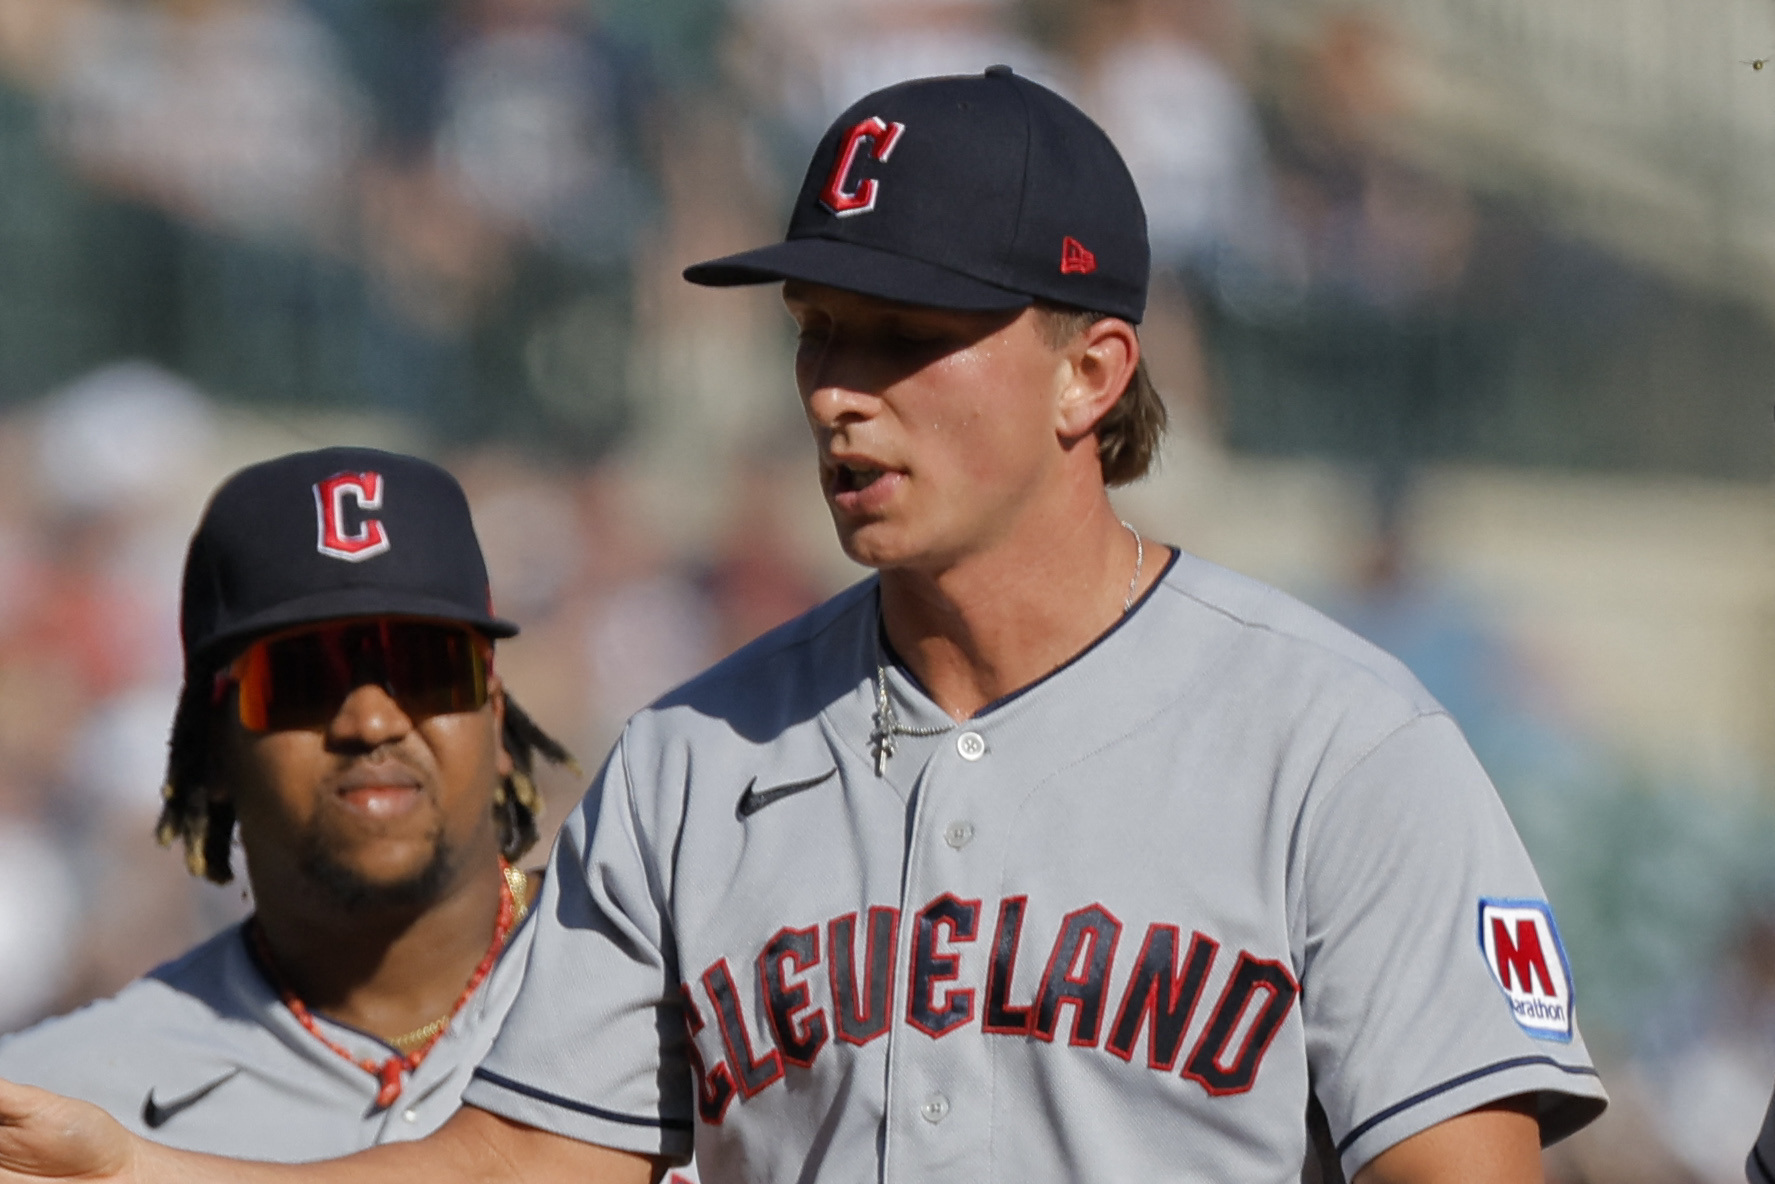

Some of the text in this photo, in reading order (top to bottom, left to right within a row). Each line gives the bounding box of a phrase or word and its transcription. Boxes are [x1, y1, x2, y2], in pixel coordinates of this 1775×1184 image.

[819, 116, 905, 218] C
[312, 470, 390, 562] C
[1490, 915, 1557, 997] M
[680, 892, 1302, 1125] CLEVELAND
[1512, 998, 1565, 1021] arathon
